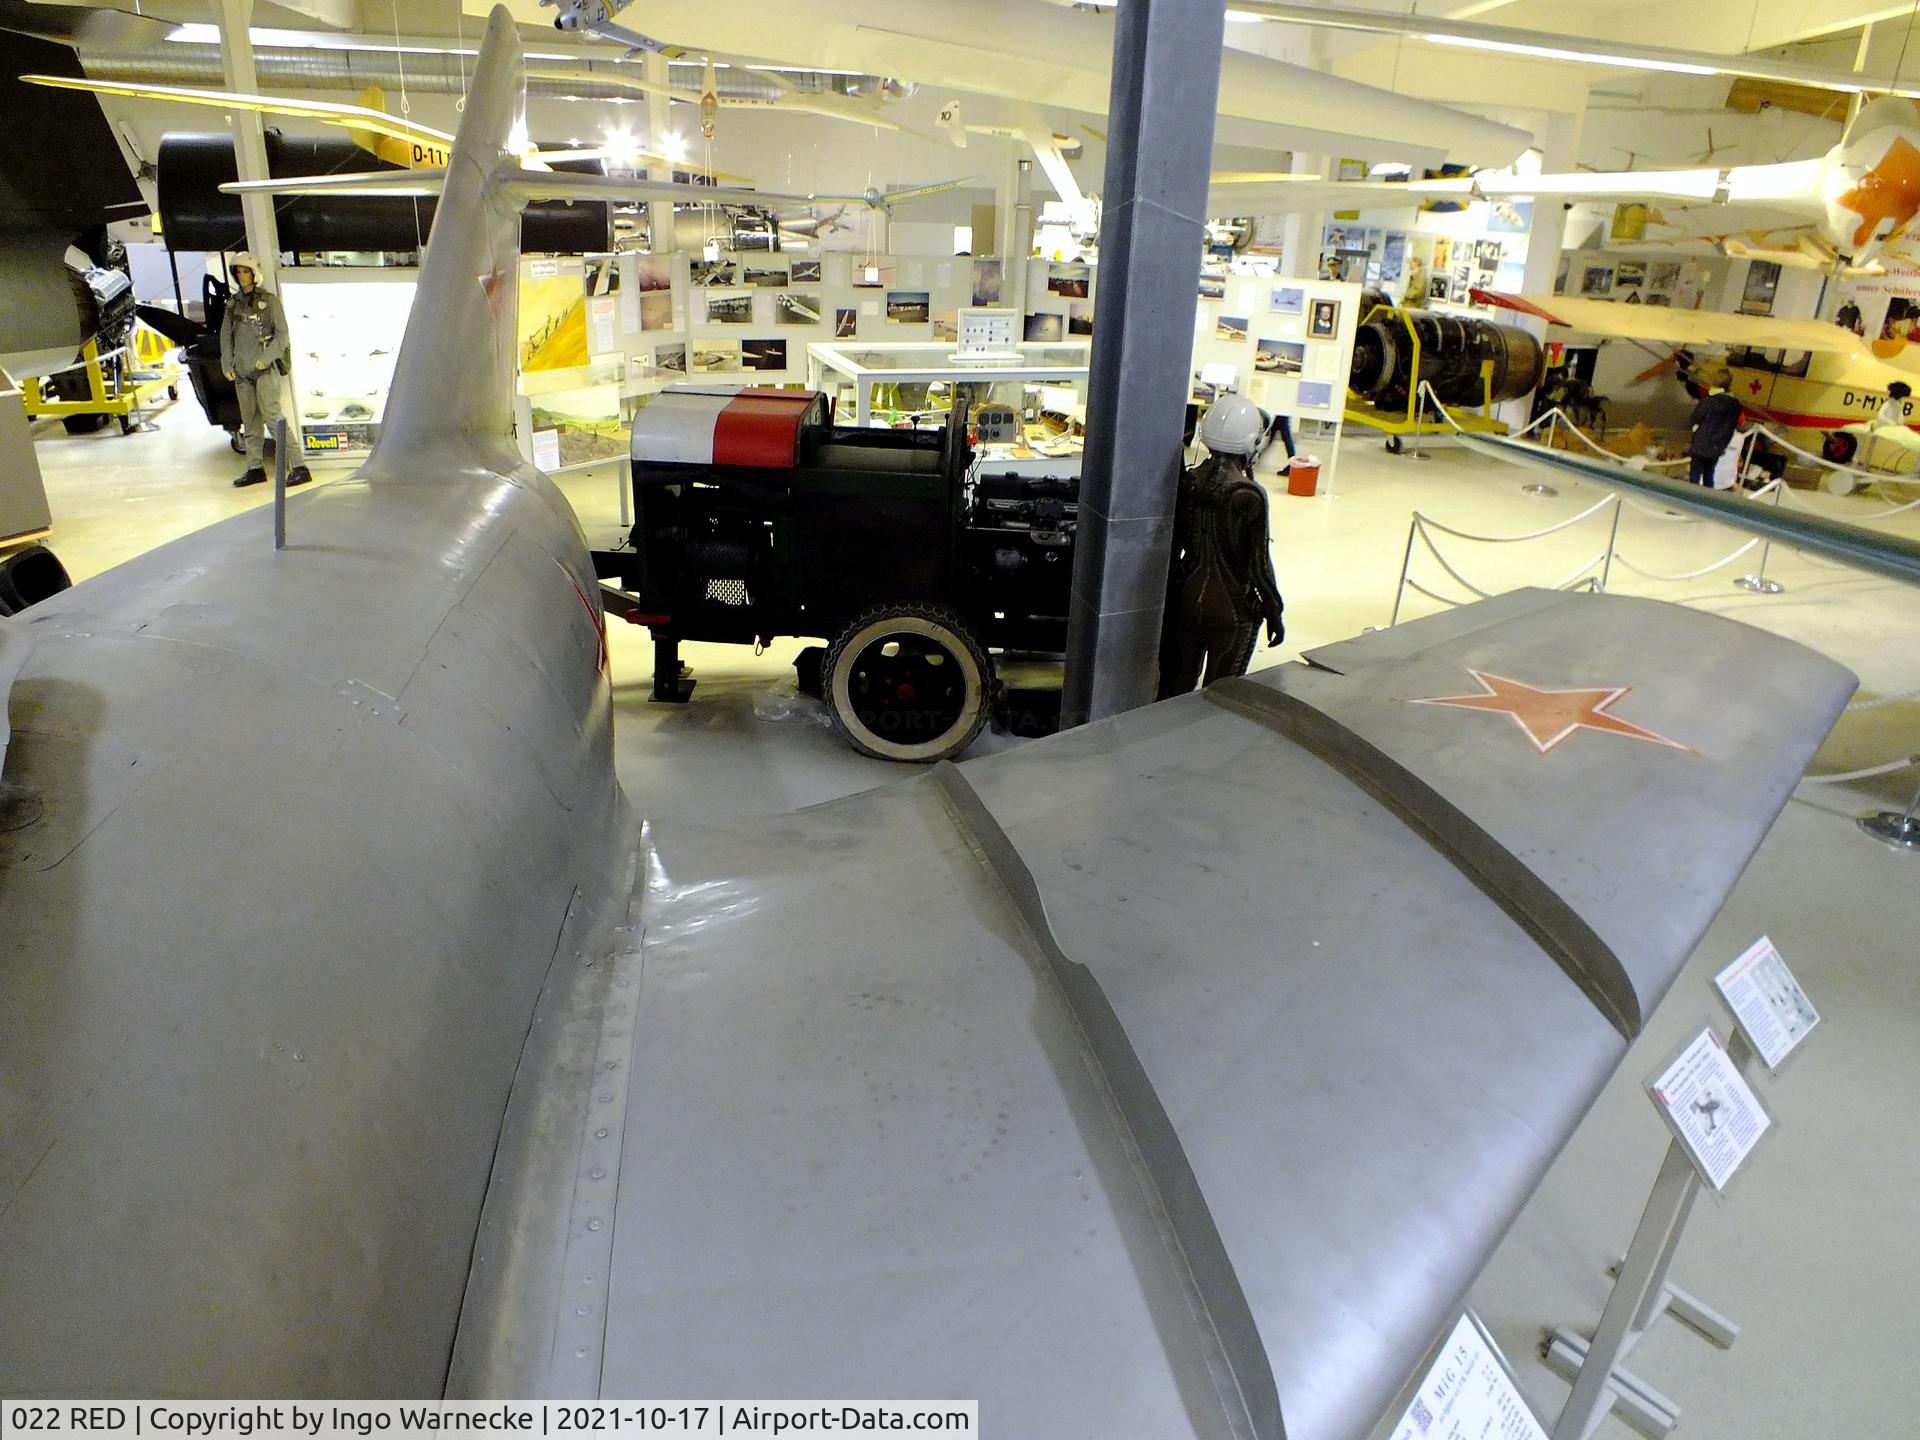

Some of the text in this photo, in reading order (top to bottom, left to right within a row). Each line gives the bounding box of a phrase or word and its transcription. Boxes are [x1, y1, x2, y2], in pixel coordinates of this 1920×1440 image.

[941, 111, 952, 121] 10
[1843, 391, 1914, 416] D-MB
[306, 435, 338, 449] Revell
[1455, 1345, 1468, 1367] 15
